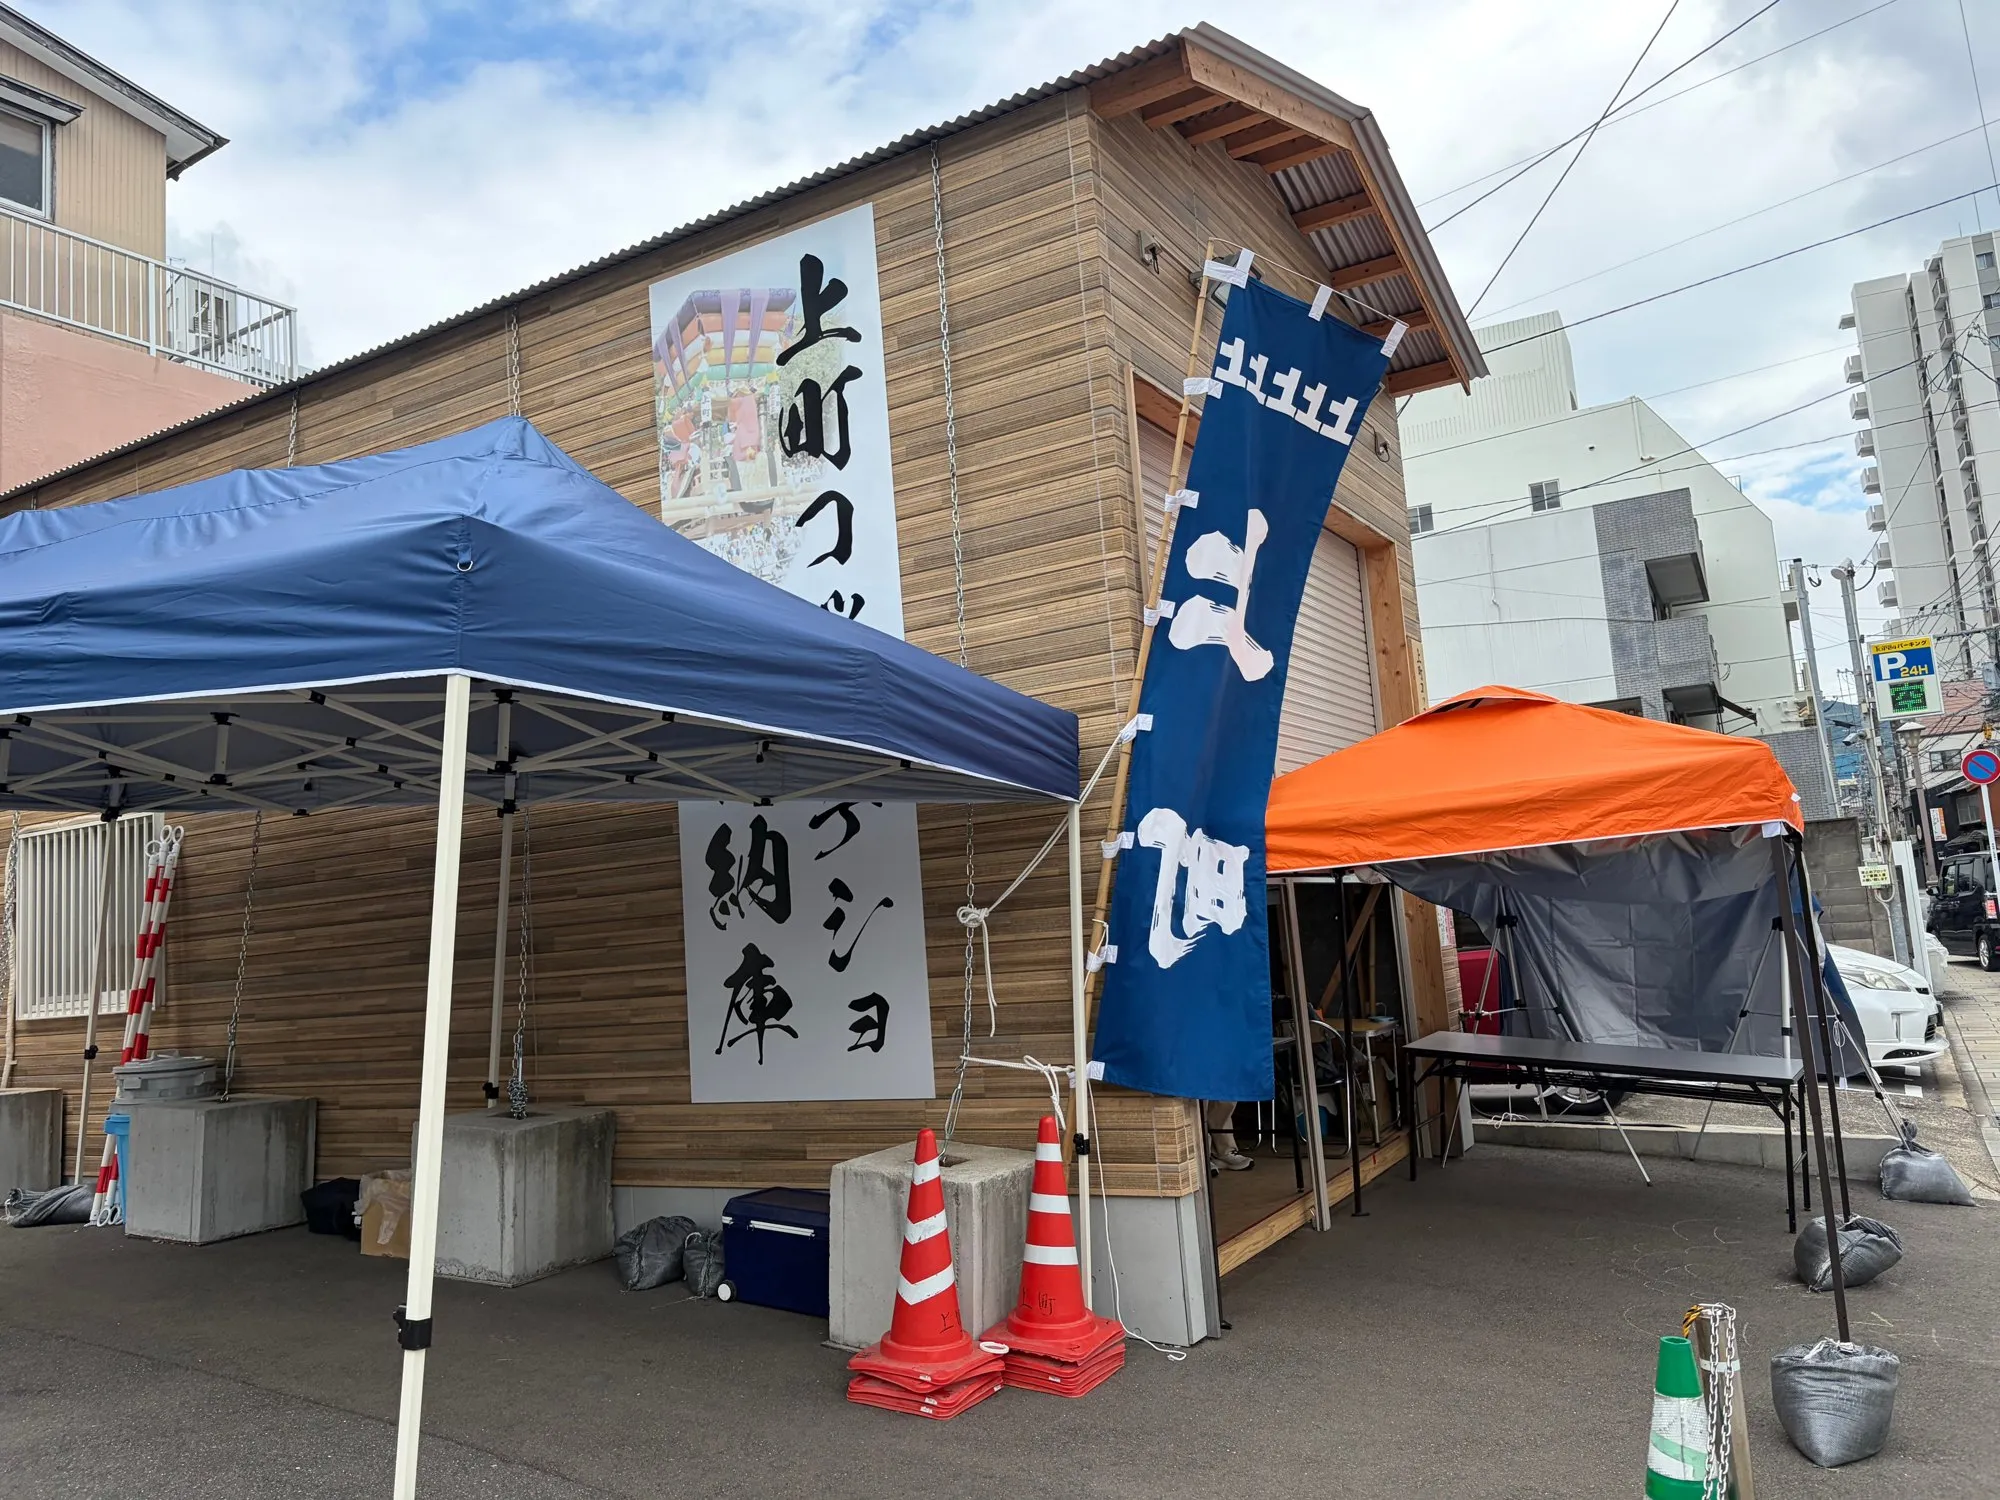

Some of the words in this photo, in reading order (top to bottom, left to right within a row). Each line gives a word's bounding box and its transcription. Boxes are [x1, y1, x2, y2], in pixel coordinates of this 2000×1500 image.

[1878, 652, 1907, 680] P
[1900, 664, 1928, 678] 24H
[1890, 683, 1927, 713] 空
[705, 802, 799, 1065] 納庫
